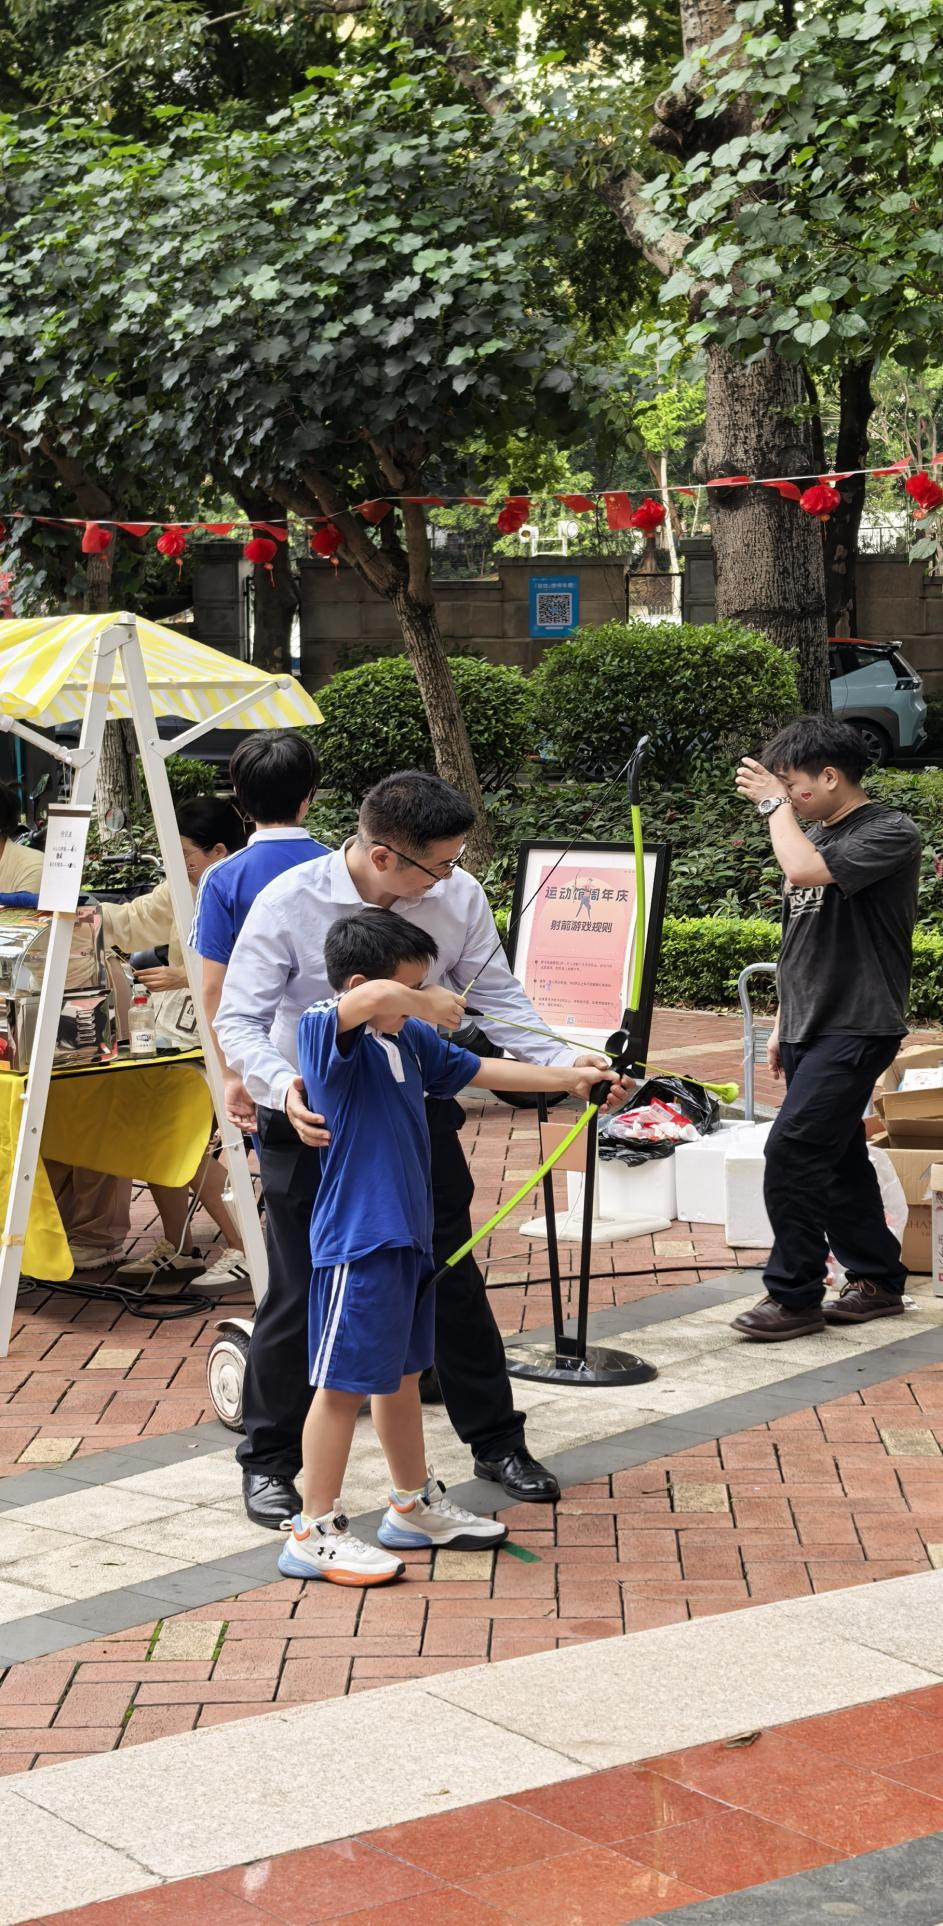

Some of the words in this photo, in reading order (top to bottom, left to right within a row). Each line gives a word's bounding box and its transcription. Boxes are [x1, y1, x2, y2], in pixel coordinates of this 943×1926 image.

[544, 886, 630, 902] 运动馆周年庆
[550, 920, 613, 933] 射箭游戏规则
